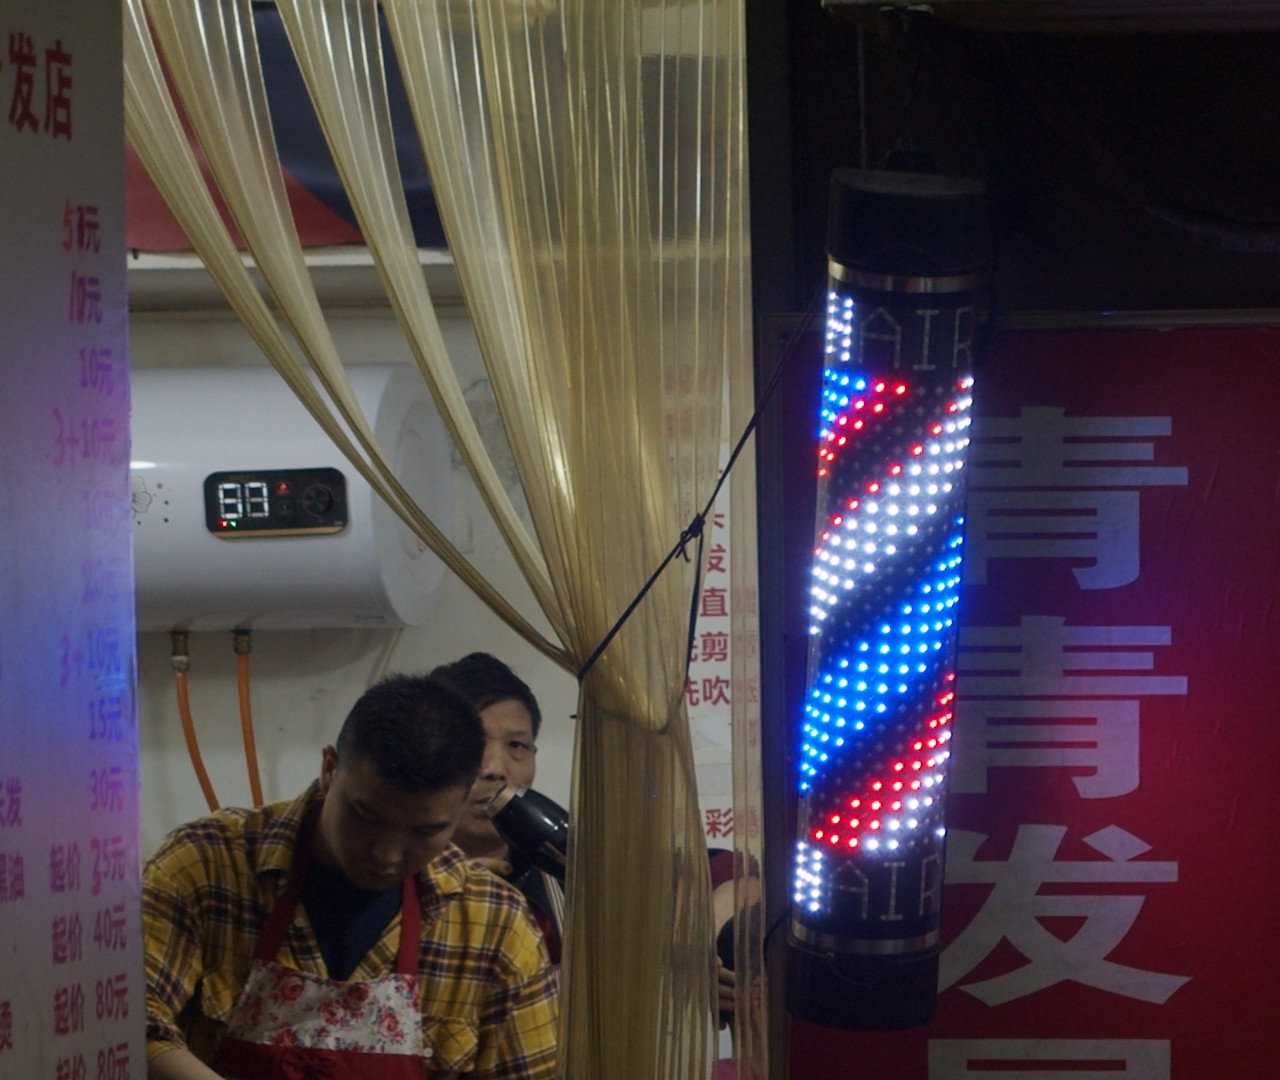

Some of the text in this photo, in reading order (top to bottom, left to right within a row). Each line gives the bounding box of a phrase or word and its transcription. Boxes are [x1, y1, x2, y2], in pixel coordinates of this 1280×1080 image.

[0, 32, 72, 141] 发店
[0, 777, 22, 827] 发
[50, 842, 80, 892] 起价
[52, 904, 127, 964] 起价 40元
[54, 983, 84, 1036] 起价
[96, 973, 128, 1020] 80元
